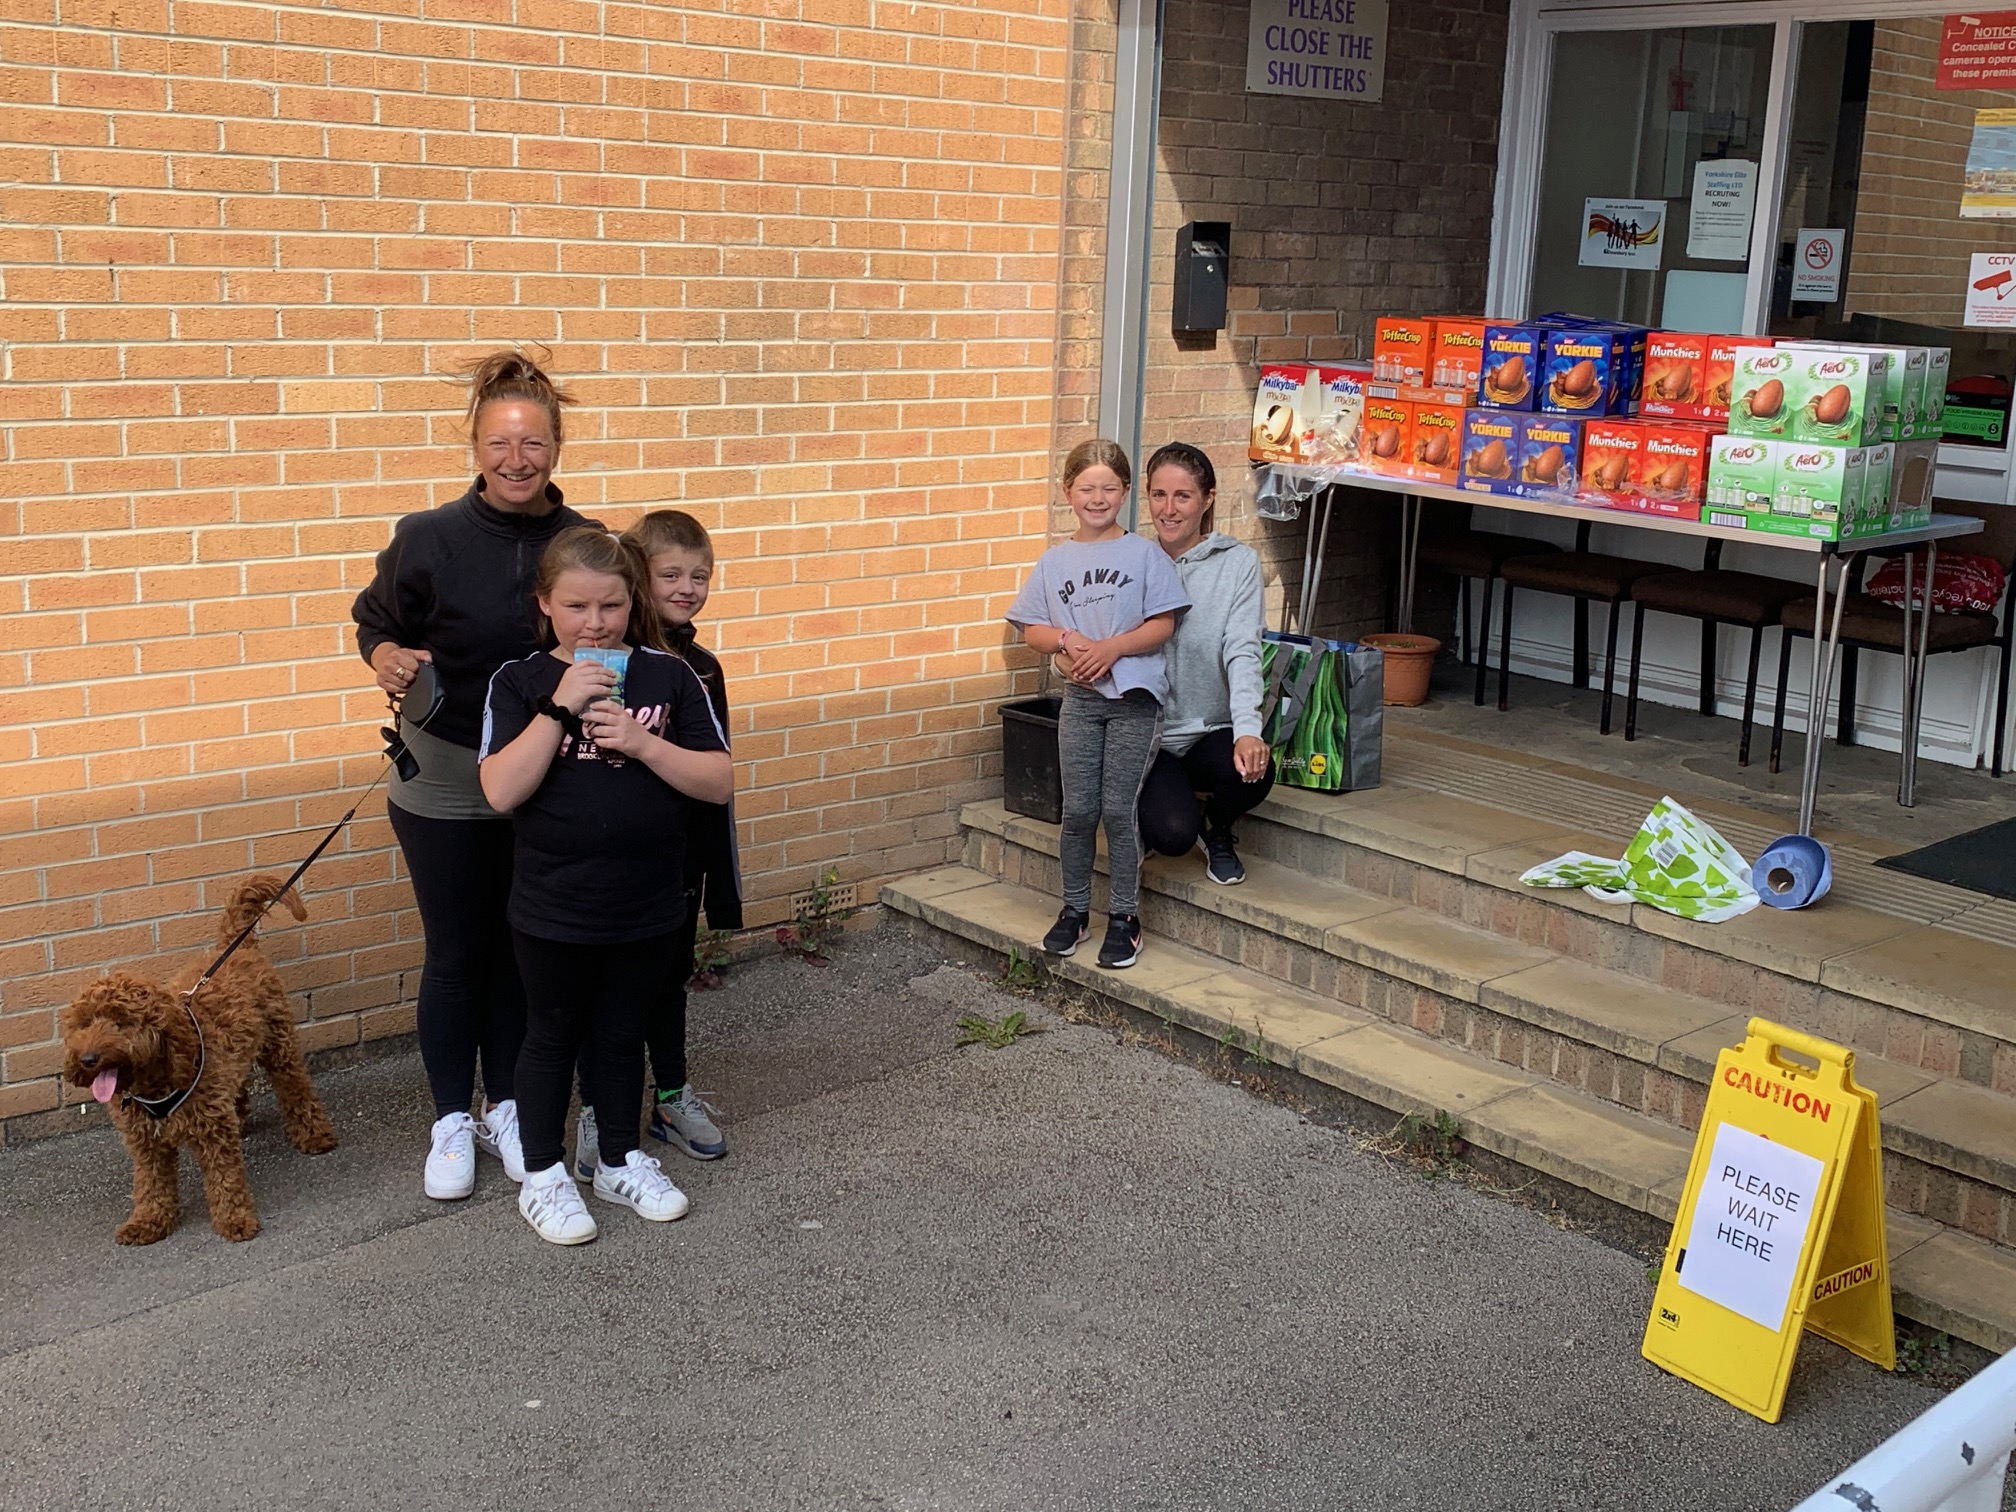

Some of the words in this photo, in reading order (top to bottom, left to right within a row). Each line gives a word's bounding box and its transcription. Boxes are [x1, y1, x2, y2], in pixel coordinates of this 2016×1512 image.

[1288, 0, 1356, 24] PLEASE
[1265, 25, 1330, 55] CLOSE
[1338, 33, 1373, 60] THE
[1952, 40, 2006, 52] Concealed
[1943, 56, 1985, 65] cameras
[1267, 60, 1366, 93] SHUTTERS
[1953, 68, 1980, 78] these
[1988, 256, 2015, 265] CCTV
[1489, 339, 1532, 354] YORKIE
[1554, 344, 1603, 358] YORKIE
[1650, 344, 1701, 359] Munchies
[1263, 378, 1299, 391] Milkybar
[1331, 382, 1362, 395] Milkyb
[1470, 422, 1513, 438] YORKIE
[1526, 428, 1572, 443] YORKIE
[1990, 424, 1997, 433] 5
[1589, 433, 1637, 450] Munchies
[1647, 439, 1698, 456] Munchies
[1058, 580, 1075, 605] GO
[1083, 569, 1134, 589] AWAY
[1724, 1066, 1831, 1123] CAUTION
[1722, 1165, 1801, 1213] PLEASE
[1728, 1196, 1779, 1233] WAIT
[1717, 1222, 1774, 1263] HERE
[1814, 1262, 1873, 1301] CAUTION
